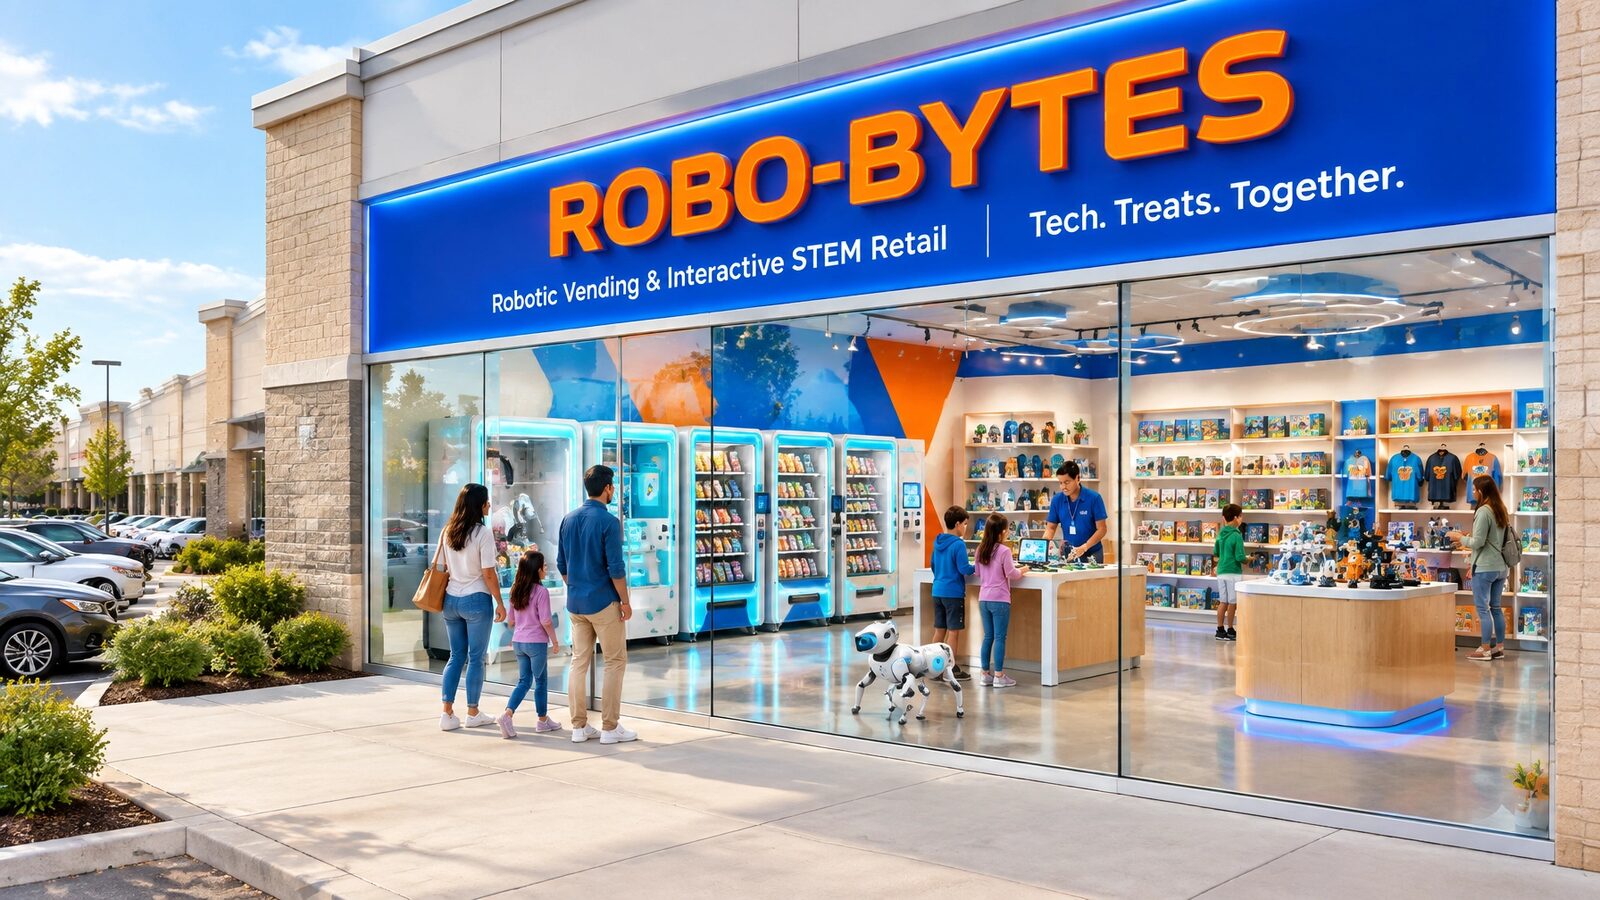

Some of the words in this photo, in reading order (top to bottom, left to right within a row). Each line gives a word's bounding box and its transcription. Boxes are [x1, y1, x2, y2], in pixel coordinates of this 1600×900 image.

[548, 29, 1294, 258] ROBO-BYTES
[1029, 203, 1106, 238] Tech.
[1113, 190, 1221, 227] Treats.
[1230, 165, 1405, 213] Together.
[492, 289, 558, 313] Robotic
[563, 275, 640, 302] Vending
[646, 269, 661, 292] &
[668, 257, 785, 289] Interactive
[791, 238, 862, 271] STEM
[871, 224, 947, 260] Retail
